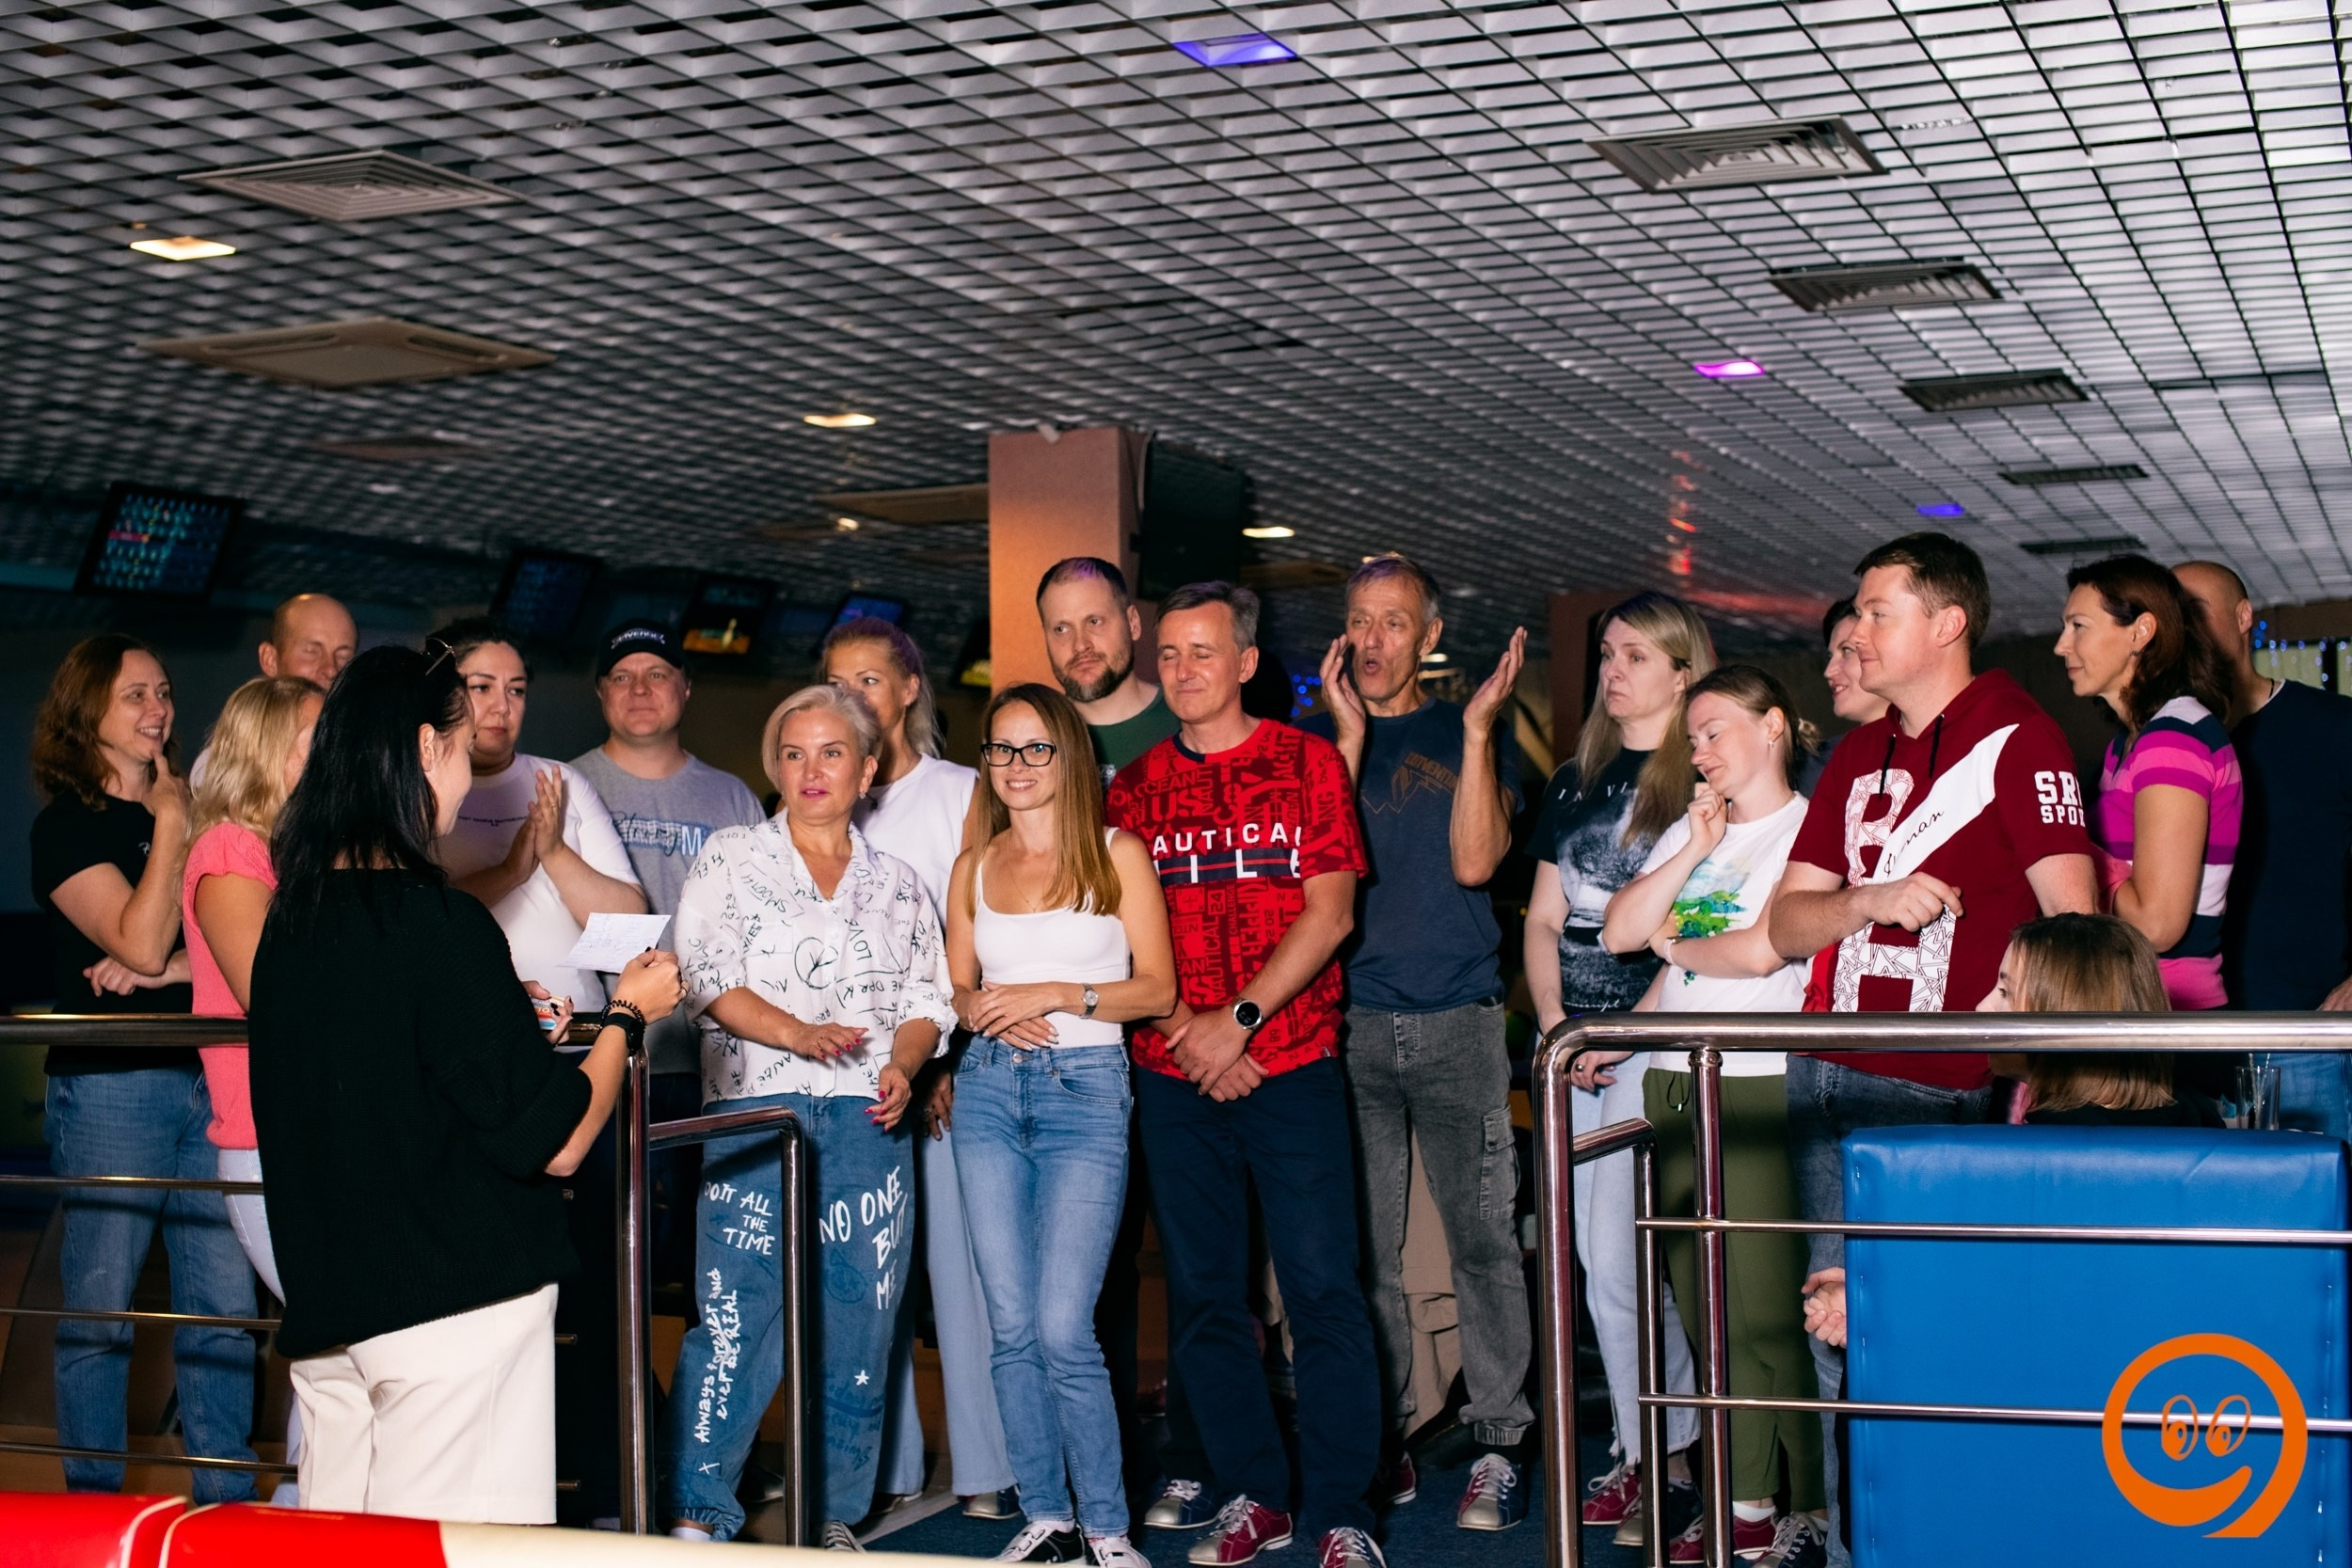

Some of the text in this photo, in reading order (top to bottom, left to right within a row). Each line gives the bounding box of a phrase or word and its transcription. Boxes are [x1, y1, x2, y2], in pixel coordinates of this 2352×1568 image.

[739, 1191, 772, 1216] ALL
[742, 1214, 769, 1232] THE
[818, 1165, 903, 1244] NO ONE
[723, 1227, 775, 1255] TIME
[872, 1193, 909, 1269] BUT
[721, 1290, 741, 1340] REAL
[694, 1375, 716, 1443] Always
